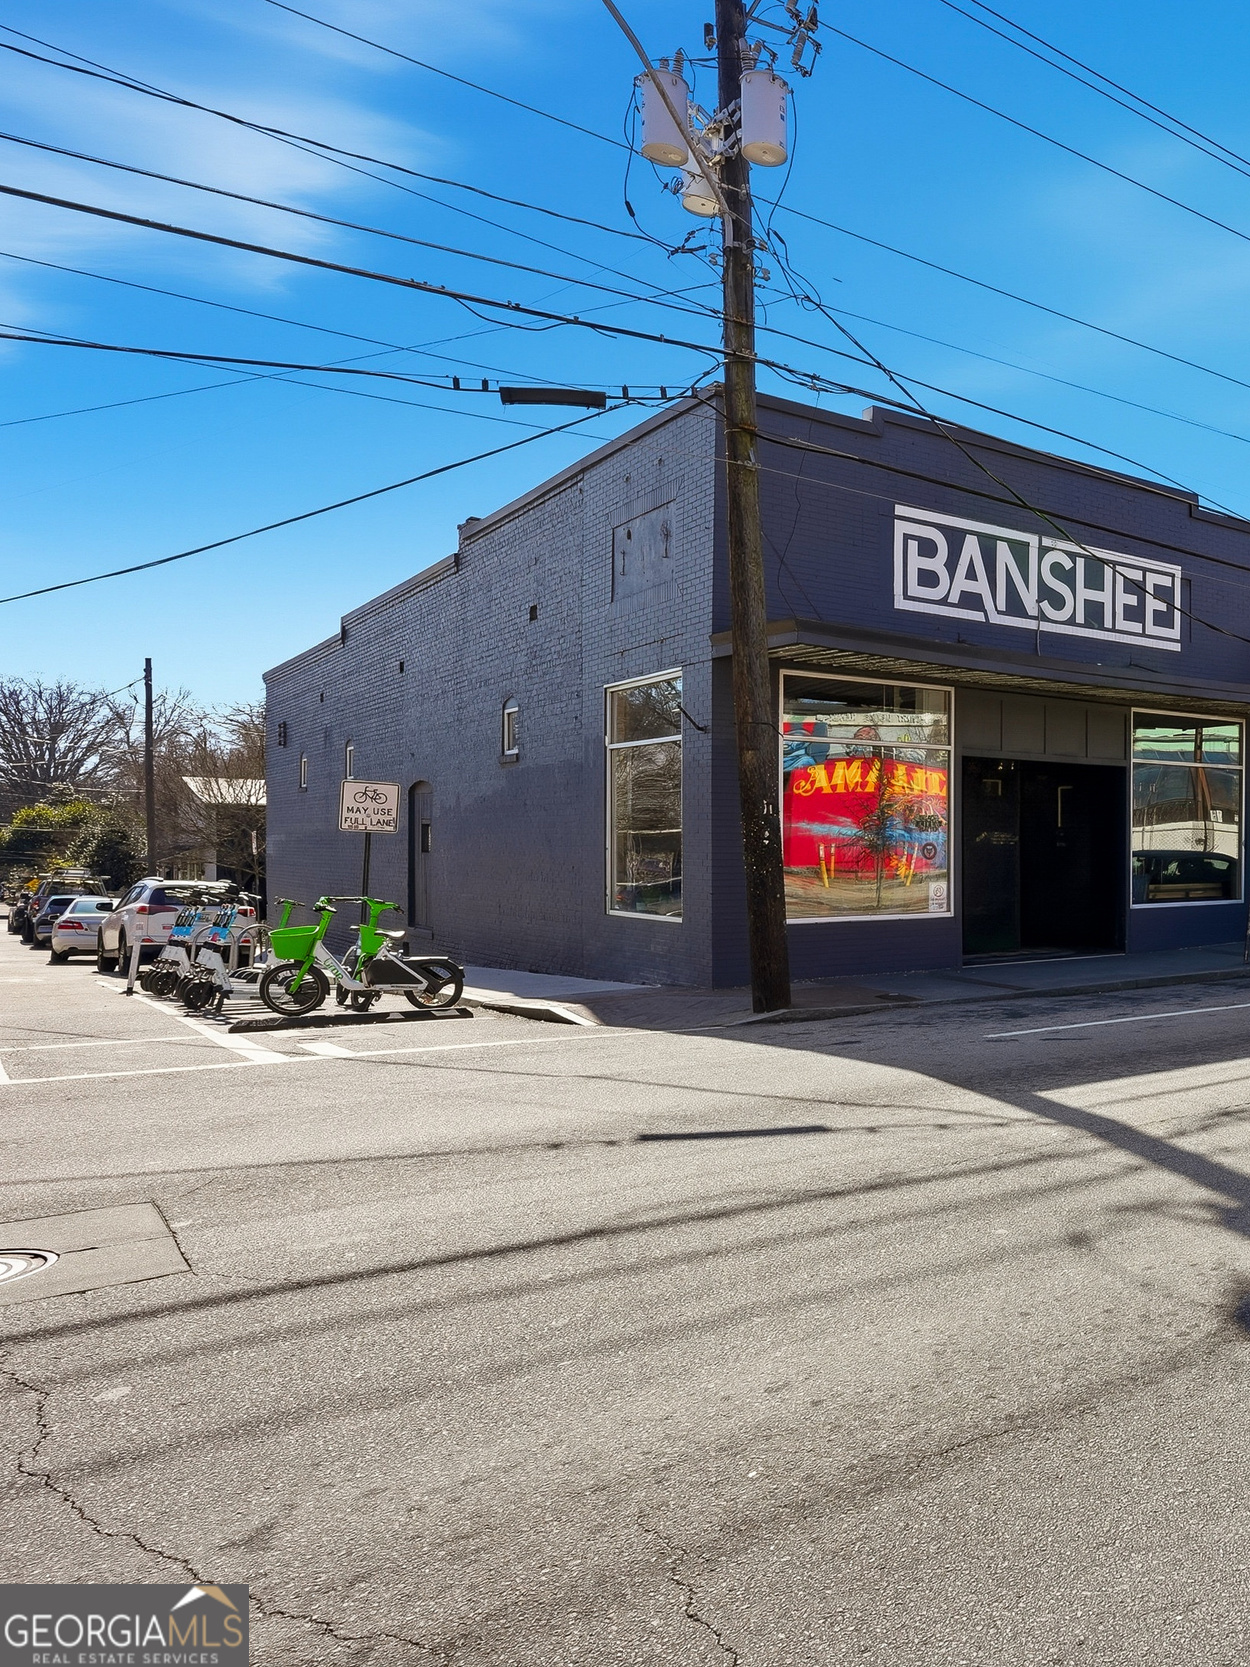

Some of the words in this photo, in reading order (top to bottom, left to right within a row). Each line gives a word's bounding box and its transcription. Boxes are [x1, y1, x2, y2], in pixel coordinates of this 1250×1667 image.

[894, 514, 1182, 641] BANSHEE
[346, 805, 369, 815] MAY
[372, 807, 393, 817] USE
[344, 816, 367, 826] FULL
[370, 817, 395, 828] LANE
